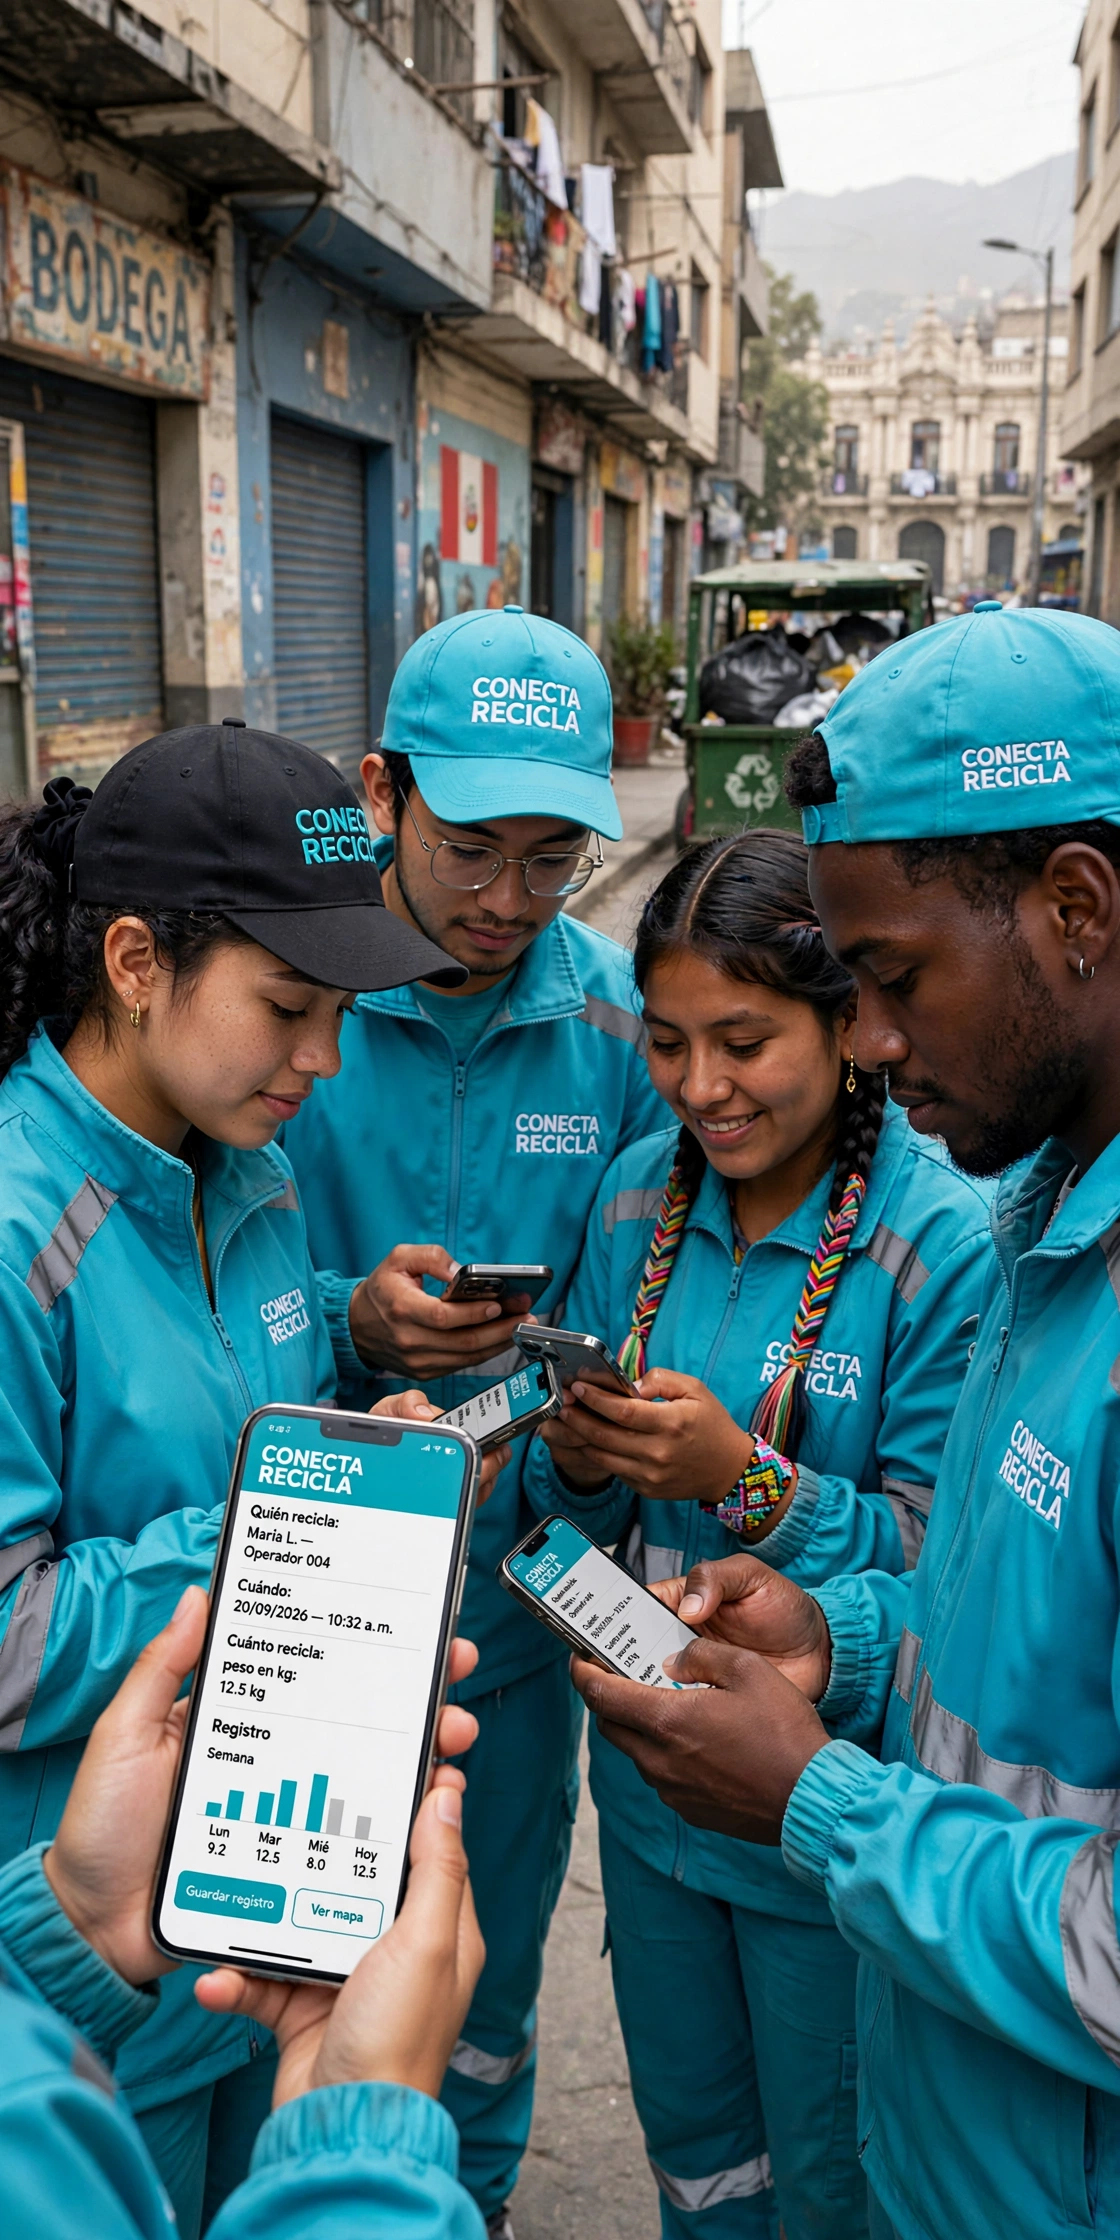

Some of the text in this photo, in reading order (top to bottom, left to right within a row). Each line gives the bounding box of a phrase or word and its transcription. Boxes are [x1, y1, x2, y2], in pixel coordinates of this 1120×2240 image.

[30, 212, 192, 364] BODEGA
[472, 677, 581, 710] CONECTA
[471, 701, 580, 734] RECICLA
[961, 740, 1071, 768] CONECTA
[963, 761, 1072, 792] RECICLA
[296, 807, 369, 834] CONEC
[302, 836, 376, 864] RECICL
[515, 1113, 600, 1134] CONECTA
[516, 1134, 598, 1154] RECICLA
[260, 1288, 305, 1323] CONECTA
[268, 1307, 311, 1346] RECICLA
[766, 1341, 862, 1378] COECTA
[759, 1361, 858, 1401] RICLA
[261, 1444, 363, 1476] CONECTA
[1011, 1420, 1070, 1498] CONECTA
[258, 1464, 352, 1495] RECICLA
[999, 1448, 1061, 1530] RECICLA
[251, 1505, 339, 1528] Quién recicla:
[247, 1526, 282, 1542] Maria
[287, 1531, 297, 1544] L.
[244, 1545, 330, 1568] Operador 004
[238, 1579, 291, 1597] Cuándo:
[234, 1600, 308, 1621] 20/09/2026
[328, 1614, 361, 1629] 10:32
[228, 1634, 324, 1659] Cuánto recicla:
[223, 1661, 296, 1683] peso en kg:
[221, 1681, 265, 1701] 12.5 kg
[212, 1719, 270, 1740] Registro
[207, 1747, 254, 1765] Semana
[210, 1824, 377, 1863] Lun Mar Mié Hoy
[208, 1842, 376, 1879] 9.2 12.5 8.0 12.5
[186, 1885, 274, 1909] Guardar registro
[311, 1903, 363, 1924] Ver mapa
